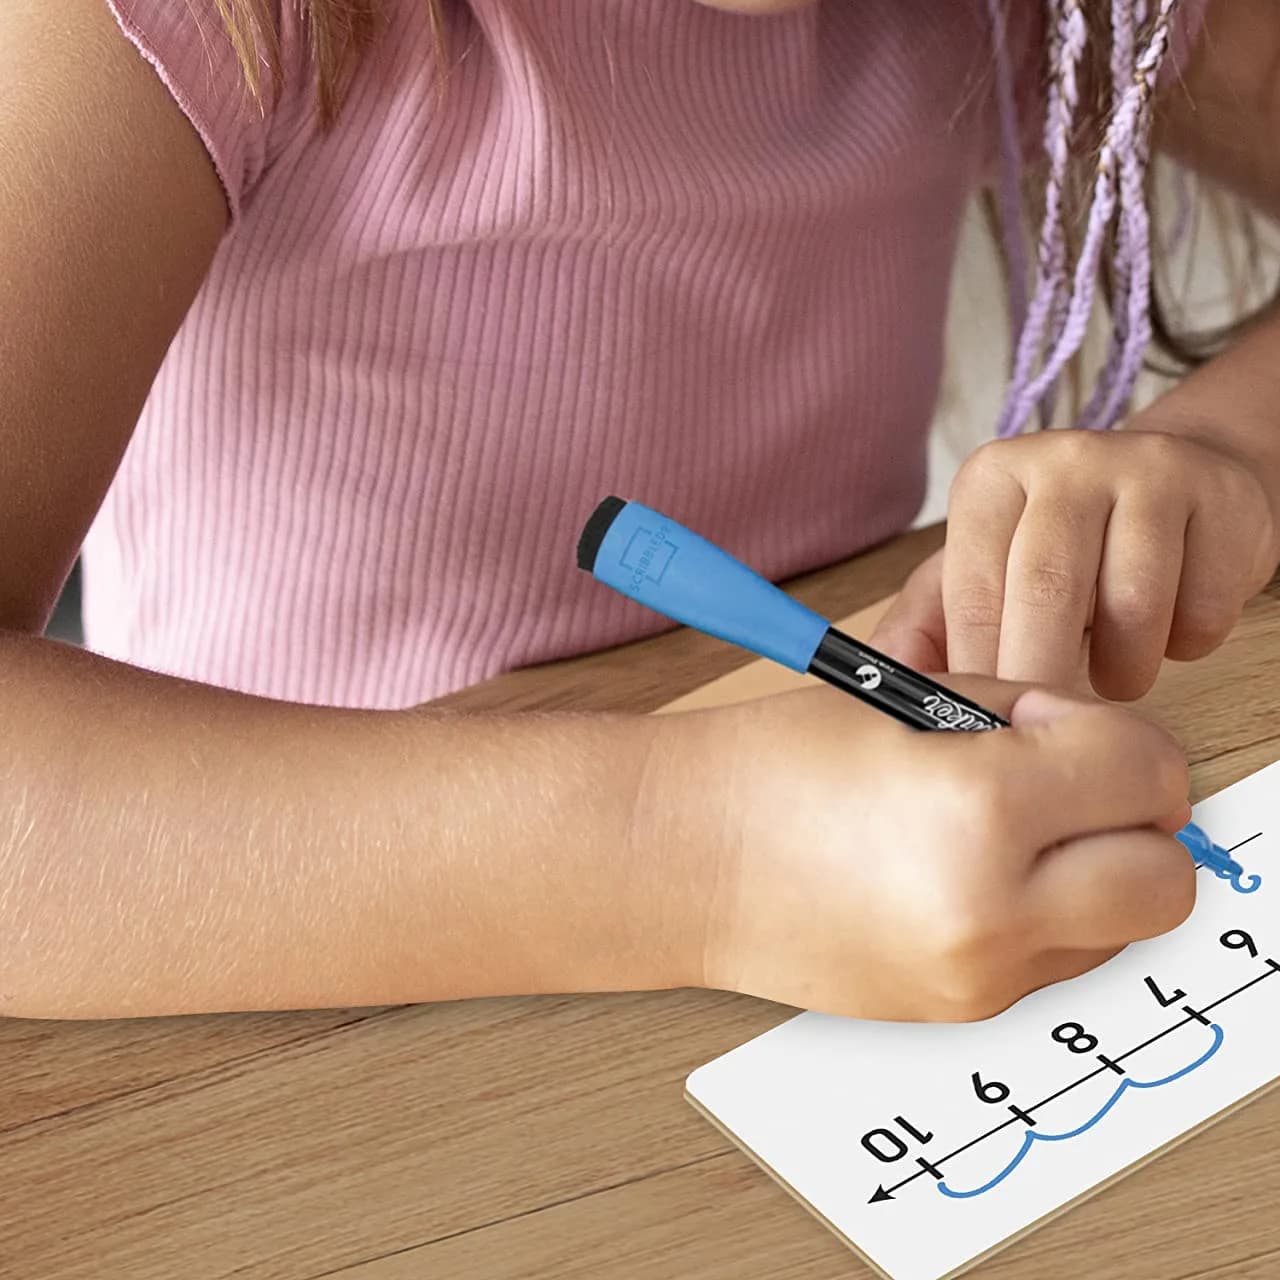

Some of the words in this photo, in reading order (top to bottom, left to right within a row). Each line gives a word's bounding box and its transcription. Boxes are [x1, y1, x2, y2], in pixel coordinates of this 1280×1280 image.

[1220, 930, 1258, 958] 6
[1144, 976, 1187, 1007] 7
[1051, 1022, 1098, 1054] 8
[972, 1072, 1010, 1104] 9
[859, 1115, 935, 1163] 10
